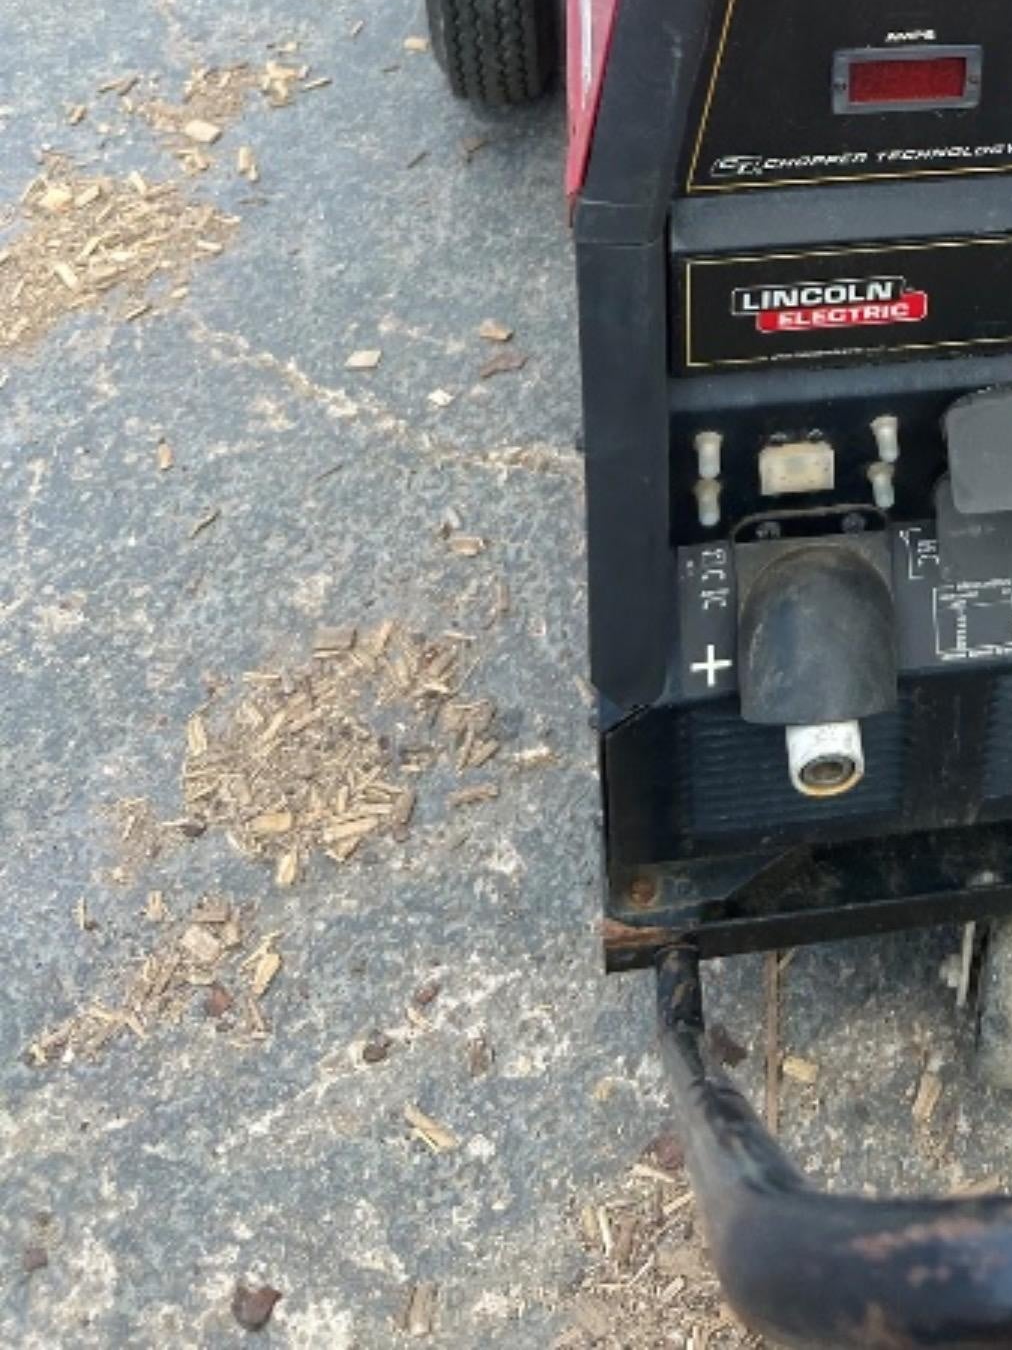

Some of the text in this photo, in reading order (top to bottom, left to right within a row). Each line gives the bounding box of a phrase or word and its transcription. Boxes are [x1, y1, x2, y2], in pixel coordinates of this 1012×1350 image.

[763, 153, 868, 169] CHOPPER
[742, 281, 895, 311] LINCOLN
[777, 302, 910, 326] ELECTRIC
